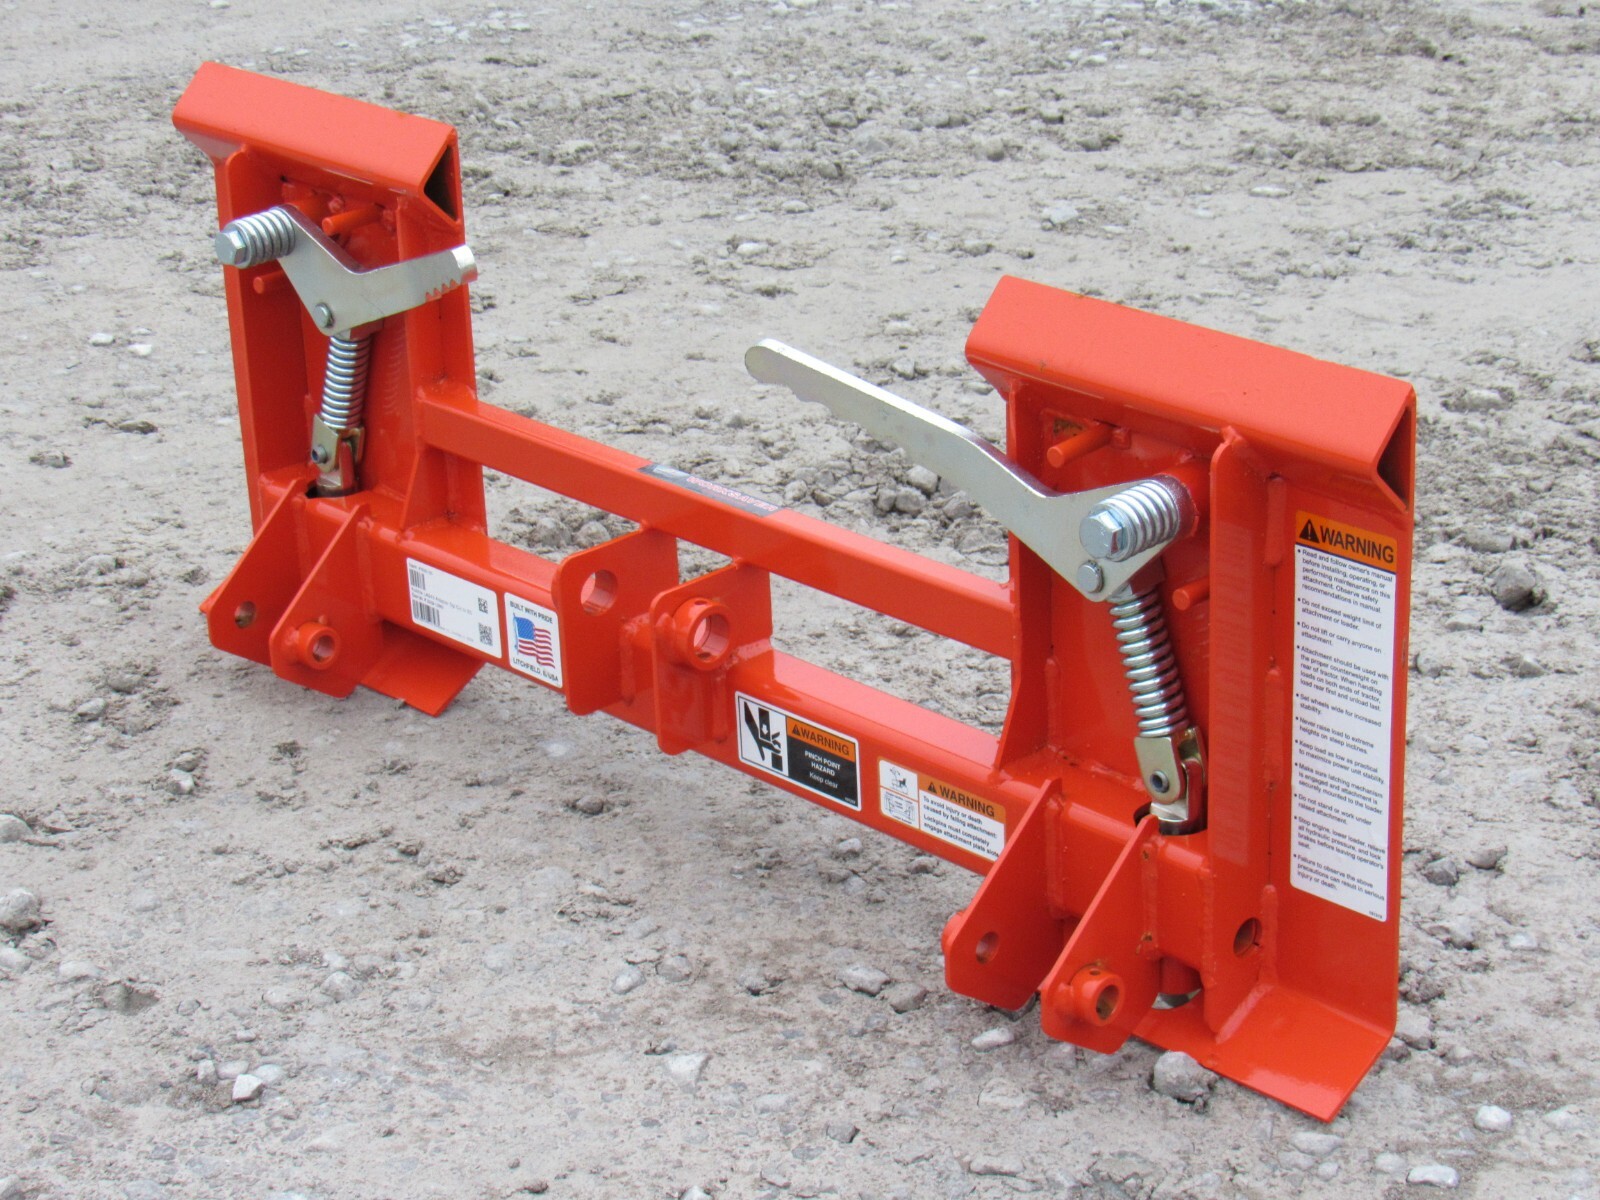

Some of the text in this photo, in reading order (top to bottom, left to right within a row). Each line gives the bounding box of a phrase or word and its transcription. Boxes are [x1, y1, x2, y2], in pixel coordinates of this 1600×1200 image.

[1320, 525, 1393, 564] WARNING
[1302, 557, 1319, 568] before
[1302, 549, 1392, 582] Read and follow owner's manual
[1302, 566, 1332, 581] performing
[1333, 576, 1369, 592] maintenance
[1380, 590, 1390, 598] this
[1302, 583, 1351, 603] recommendations
[1335, 585, 1359, 597] Observe
[1361, 593, 1378, 605] safety
[509, 600, 552, 623] BUILT WITH PRIDE
[1302, 607, 1332, 621] attachment
[1321, 604, 1341, 616] exceed
[1342, 611, 1360, 623] weight
[1362, 618, 1374, 626] limit
[1336, 634, 1350, 644] carry
[1351, 639, 1372, 651] anyone
[512, 656, 541, 675] LITCHFIELD,
[1301, 646, 1332, 661] Attachment
[1333, 656, 1352, 667] should
[1362, 666, 1375, 675] used
[1377, 671, 1388, 680] with
[1311, 658, 1328, 669] proper
[1330, 664, 1369, 683] counterweight
[1300, 670, 1315, 680] loads
[1325, 679, 1337, 687] both
[1339, 683, 1352, 692] ends
[1300, 678, 1312, 687] load
[1325, 687, 1336, 695] first
[1337, 691, 1347, 699] and
[1349, 695, 1368, 706] unload
[1340, 676, 1356, 685] When
[1357, 681, 1382, 695] handling
[1310, 697, 1329, 708] wheels
[1331, 704, 1343, 713] wide
[1354, 712, 1381, 726] increased
[801, 727, 849, 755] WARNING
[1299, 725, 1319, 738] heights
[1329, 736, 1344, 747] steep
[1300, 717, 1315, 727] Never
[1316, 723, 1330, 732] raise
[1331, 728, 1343, 737] load
[1351, 735, 1373, 748] extreme
[804, 750, 840, 770] PINCH POINT
[811, 761, 835, 776] HAZARD
[1299, 740, 1312, 751] Keep
[1314, 745, 1326, 754] load
[1354, 760, 1377, 774] practical
[1306, 751, 1331, 764] maximize
[1332, 761, 1349, 772] power
[1350, 767, 1361, 775] unit
[809, 771, 838, 788] Keep clear
[1298, 779, 1320, 793] securely
[1299, 763, 1313, 773] Make
[1328, 774, 1349, 787] latching
[1351, 782, 1382, 798] mechanism
[1304, 773, 1371, 802] engaged and attachment
[930, 799, 944, 809] avoid
[945, 805, 959, 816] injury
[967, 814, 982, 824] death
[939, 785, 994, 817] WARNING
[1317, 801, 1332, 811] stand
[1341, 809, 1354, 819] work
[1355, 815, 1371, 825] under
[923, 803, 941, 815] caused
[942, 811, 948, 819] by
[950, 814, 965, 826] falling
[923, 814, 946, 828] Lockpins
[948, 824, 960, 834] must
[962, 830, 989, 847] completely
[924, 823, 987, 854] engage attachment plate
[1298, 817, 1310, 827] Stop
[1332, 829, 1346, 839] lower
[1298, 832, 1383, 870] brakes before leaving operator's
[1305, 827, 1330, 842] hydraulic
[1358, 847, 1368, 855] and
[1369, 852, 1380, 860] lock
[1297, 855, 1315, 866] Failure
[1323, 865, 1345, 877] observe
[1356, 877, 1372, 888] above
[1297, 870, 1312, 882] injury
[1297, 862, 1328, 880] precautions
[1341, 880, 1356, 890] result
[1364, 888, 1384, 900] serious
